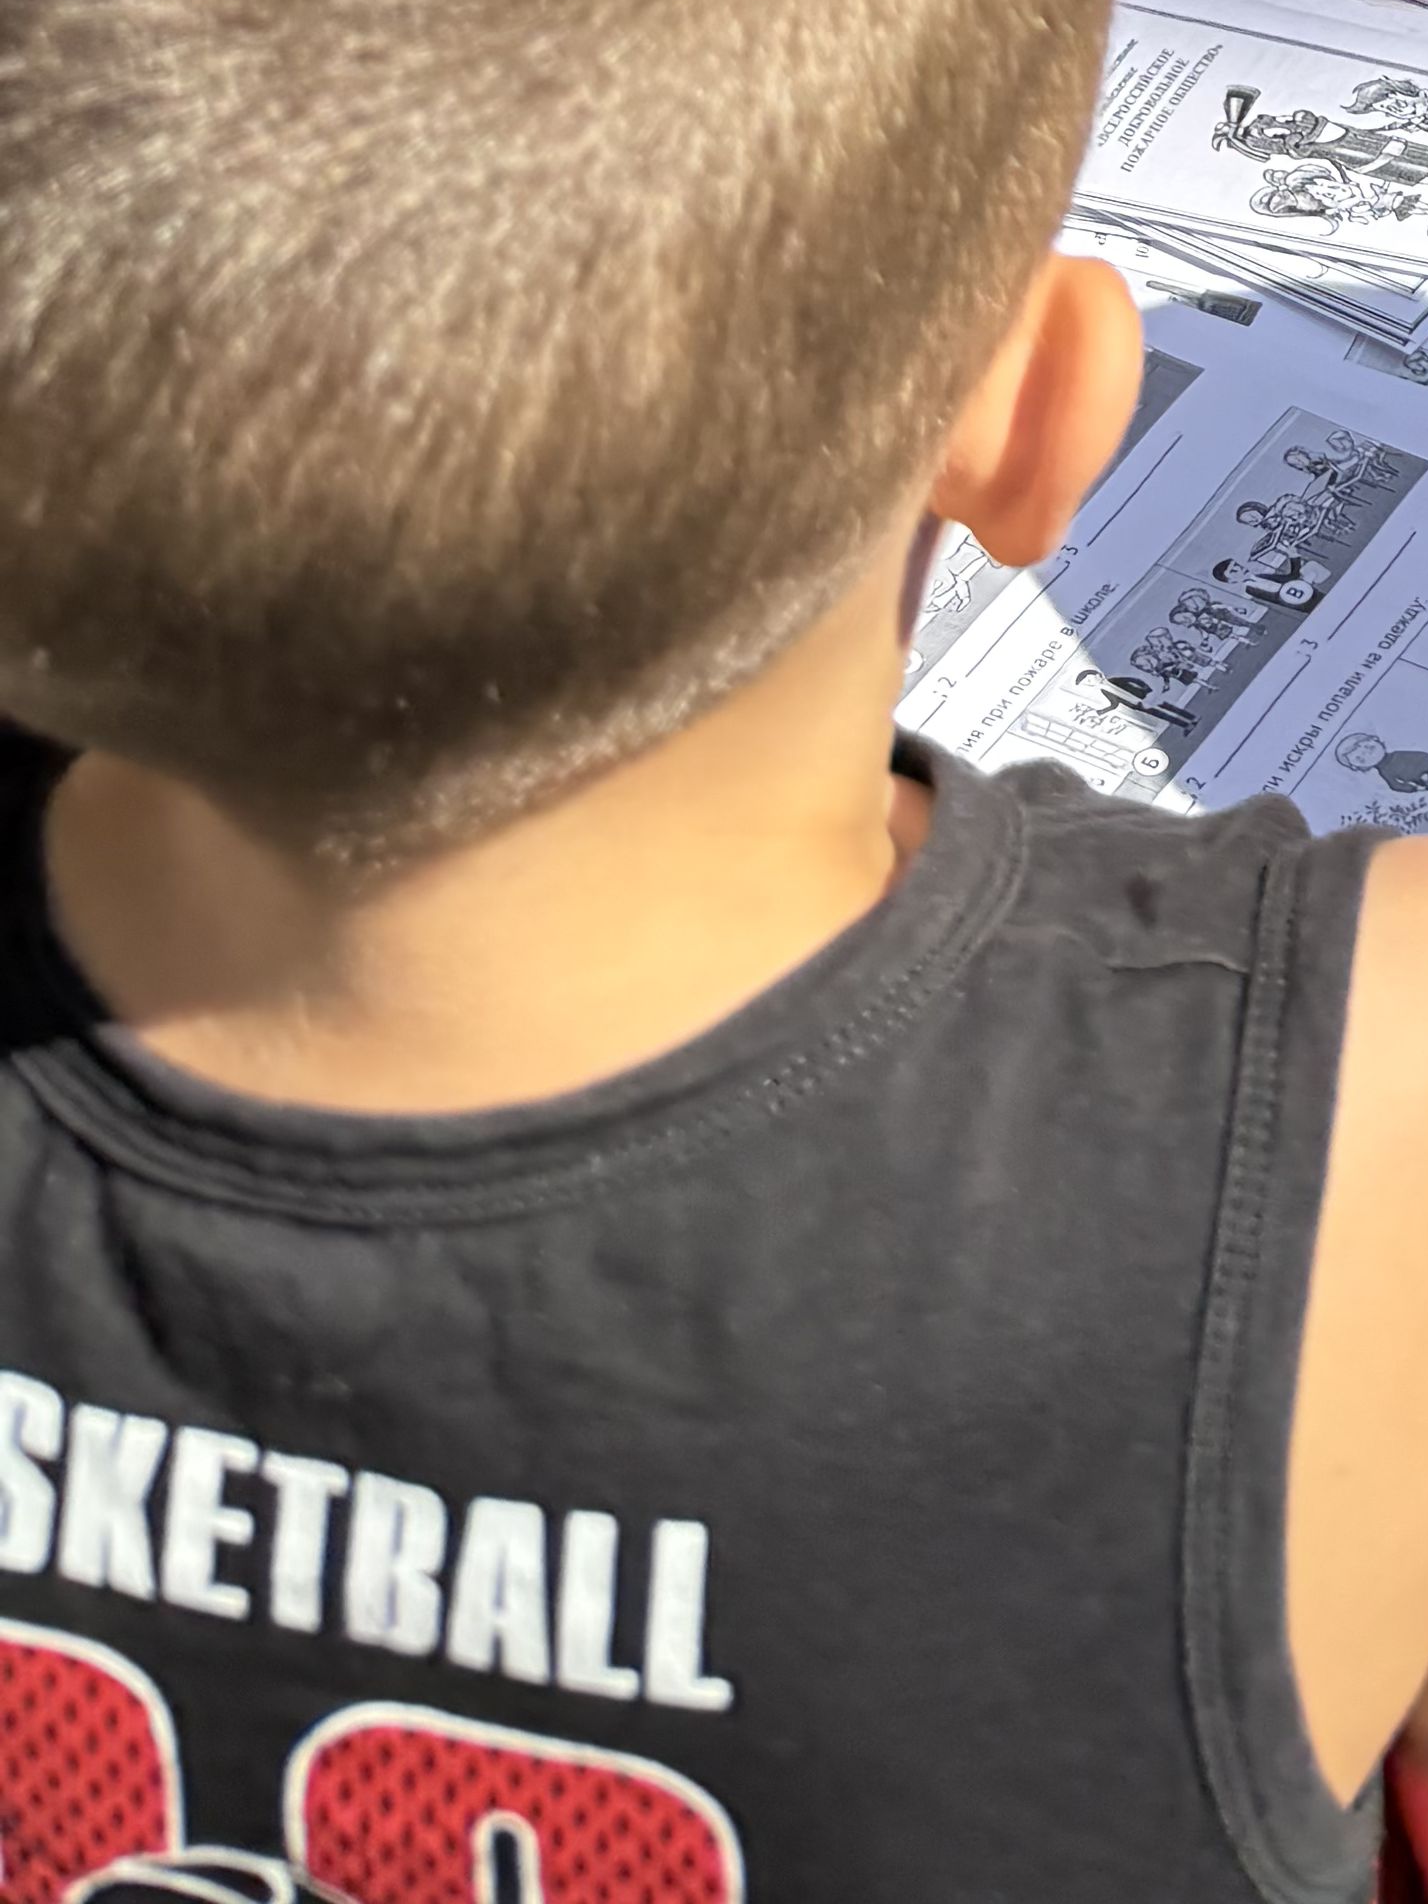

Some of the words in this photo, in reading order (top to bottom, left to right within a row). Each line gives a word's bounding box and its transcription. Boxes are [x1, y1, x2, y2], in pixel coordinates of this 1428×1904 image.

[1119, 58, 1190, 147] ДОБРОВОЛЬНОЕ
[1120, 106, 1174, 172] ПОЖАРНОЕ
[1288, 586, 1304, 599] В
[982, 700, 1012, 732] при
[1009, 639, 1063, 697] пожаре
[1060, 626, 1075, 636] в
[1278, 723, 1324, 778] искры
[1318, 669, 1364, 723] попали
[1361, 652, 1383, 671] на
[1144, 758, 1160, 769] Б
